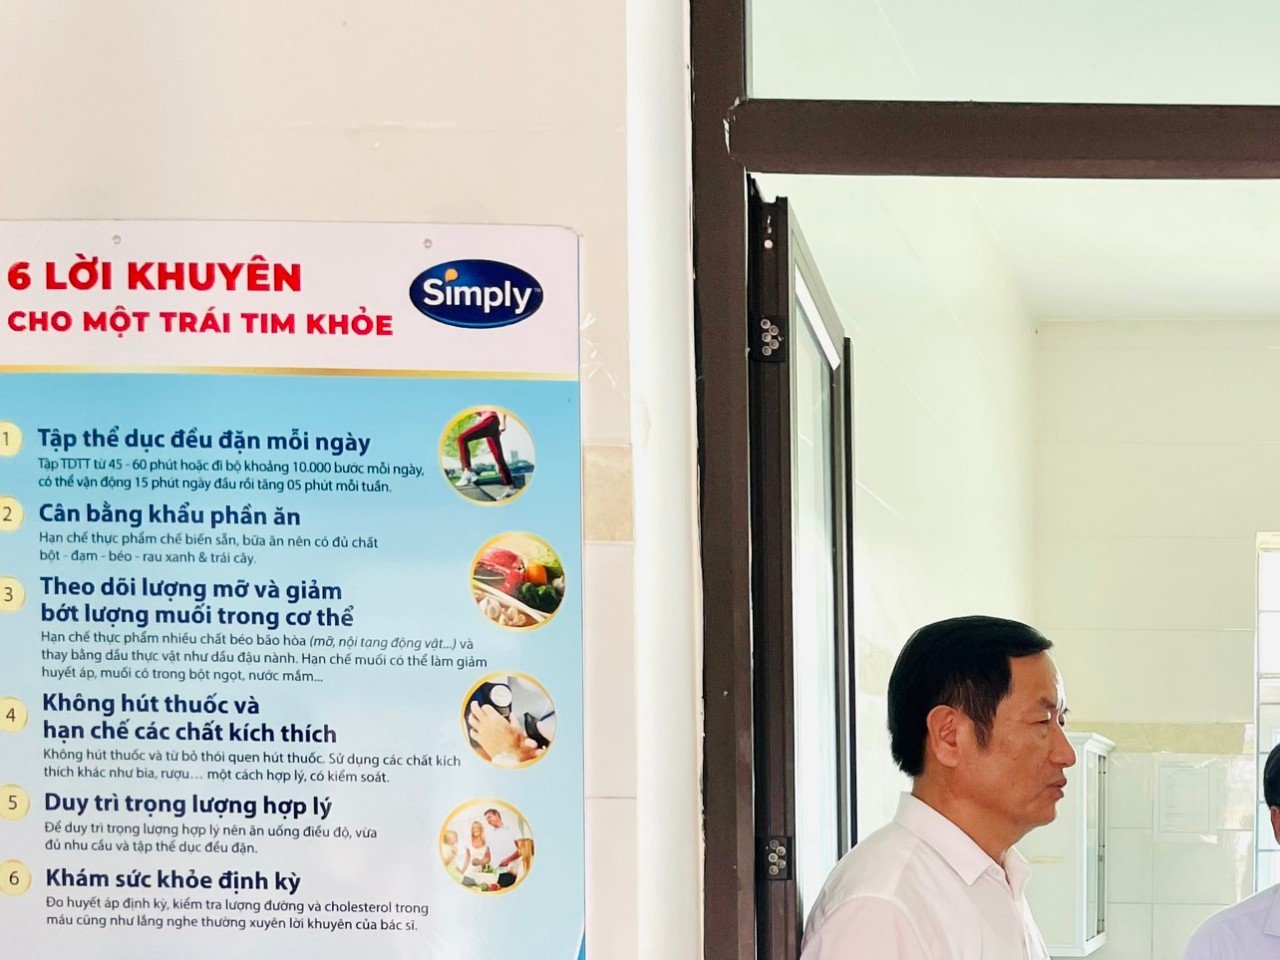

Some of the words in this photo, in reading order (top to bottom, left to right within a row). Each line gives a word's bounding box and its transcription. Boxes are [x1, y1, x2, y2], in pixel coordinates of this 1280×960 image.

[7, 261, 31, 290] 6
[45, 253, 111, 290] LỜI
[128, 255, 300, 291] KHUYÊN
[423, 268, 532, 314] Simply
[8, 310, 72, 331] CHO
[83, 305, 149, 337] MỘT
[159, 306, 230, 332] TRÁI
[240, 313, 294, 333] TIM
[306, 307, 392, 335] KHỎE
[3, 432, 9, 446] 1
[37, 428, 76, 451] Tập
[82, 426, 119, 447] thể
[124, 428, 164, 452] dục
[170, 428, 212, 448] đều
[218, 429, 260, 454] đặn
[267, 429, 308, 449] mỗi
[316, 432, 370, 456] ngày
[3, 506, 12, 521] 2
[39, 503, 80, 521] Cân
[86, 502, 142, 527] bằng
[149, 503, 203, 523] khẩu
[210, 504, 266, 529] phần
[273, 506, 300, 525] ăn
[4, 587, 13, 601] 3
[40, 576, 94, 594] Theo
[100, 577, 135, 595] dõi
[142, 578, 206, 601] lượng
[213, 579, 249, 597] mỡ
[254, 579, 279, 598] và
[286, 580, 341, 603] giảm
[41, 603, 78, 621] bớt
[85, 603, 148, 627] lượng
[155, 604, 211, 623] muối
[217, 608, 278, 629] trong
[286, 610, 311, 625] cơ
[316, 605, 354, 626] thể
[42, 666, 76, 680] huyết
[100, 667, 131, 678] muối
[134, 667, 148, 678] có
[152, 669, 185, 681] trong
[189, 668, 209, 679] bột
[248, 669, 278, 680] nước
[6, 707, 15, 722] 4
[43, 693, 114, 716] Không
[121, 694, 158, 712] hút
[164, 694, 228, 713] thuốc
[234, 695, 258, 714] và
[44, 720, 84, 743] hạn
[90, 719, 129, 739] chế
[134, 721, 169, 739] các
[176, 721, 222, 740] chất
[229, 722, 274, 741] kích
[280, 724, 336, 742] thích
[44, 748, 82, 762] Không
[86, 749, 106, 760] hút
[110, 749, 144, 760] thuốc
[148, 750, 162, 760] và
[182, 750, 197, 761] bỏ
[200, 750, 224, 761] thói
[228, 754, 259, 764] quen
[263, 751, 283, 762] hút
[329, 752, 344, 764] Sử
[347, 753, 379, 767] dụng
[382, 754, 402, 765] các
[406, 754, 432, 765] chất
[436, 755, 460, 766] kích
[44, 766, 73, 776] thích
[78, 766, 105, 777] khác
[109, 767, 133, 777] như
[136, 767, 157, 779] bia,
[207, 768, 231, 781] một
[235, 769, 262, 780] cách
[266, 769, 290, 783] hợp
[310, 770, 324, 781] có
[360, 771, 389, 782] soát.
[9, 795, 18, 810] 5
[45, 793, 88, 815] Duy
[94, 793, 118, 811] trì
[125, 796, 185, 817] trọng
[192, 794, 256, 818] lượng
[263, 795, 306, 819] hợp
[313, 796, 332, 820] lý
[9, 871, 20, 886] 6
[46, 868, 108, 886] Khám
[116, 869, 151, 887] sức
[157, 869, 212, 888] khỏe
[218, 871, 268, 894] định
[275, 871, 300, 895] kỳ
[46, 896, 63, 907] Đo
[67, 896, 100, 910] huyết
[104, 897, 119, 910] áp
[122, 897, 150, 908] định
[173, 897, 202, 909] kiểm
[205, 900, 221, 909] tra
[225, 899, 260, 913] lượng
[264, 900, 304, 914] đường
[307, 901, 321, 911] và
[324, 901, 391, 912] cholesterol
[395, 903, 428, 916] trong
[46, 914, 72, 924] máu
[76, 914, 106, 927] cũng
[110, 915, 134, 925] như
[137, 915, 163, 928] lắng
[166, 915, 197, 929] nghe
[201, 916, 245, 929] thường
[249, 917, 285, 930] xuyên
[289, 917, 303, 928] lời
[307, 918, 352, 932] khuyên
[355, 918, 376, 929] của
[380, 919, 401, 930] bác
